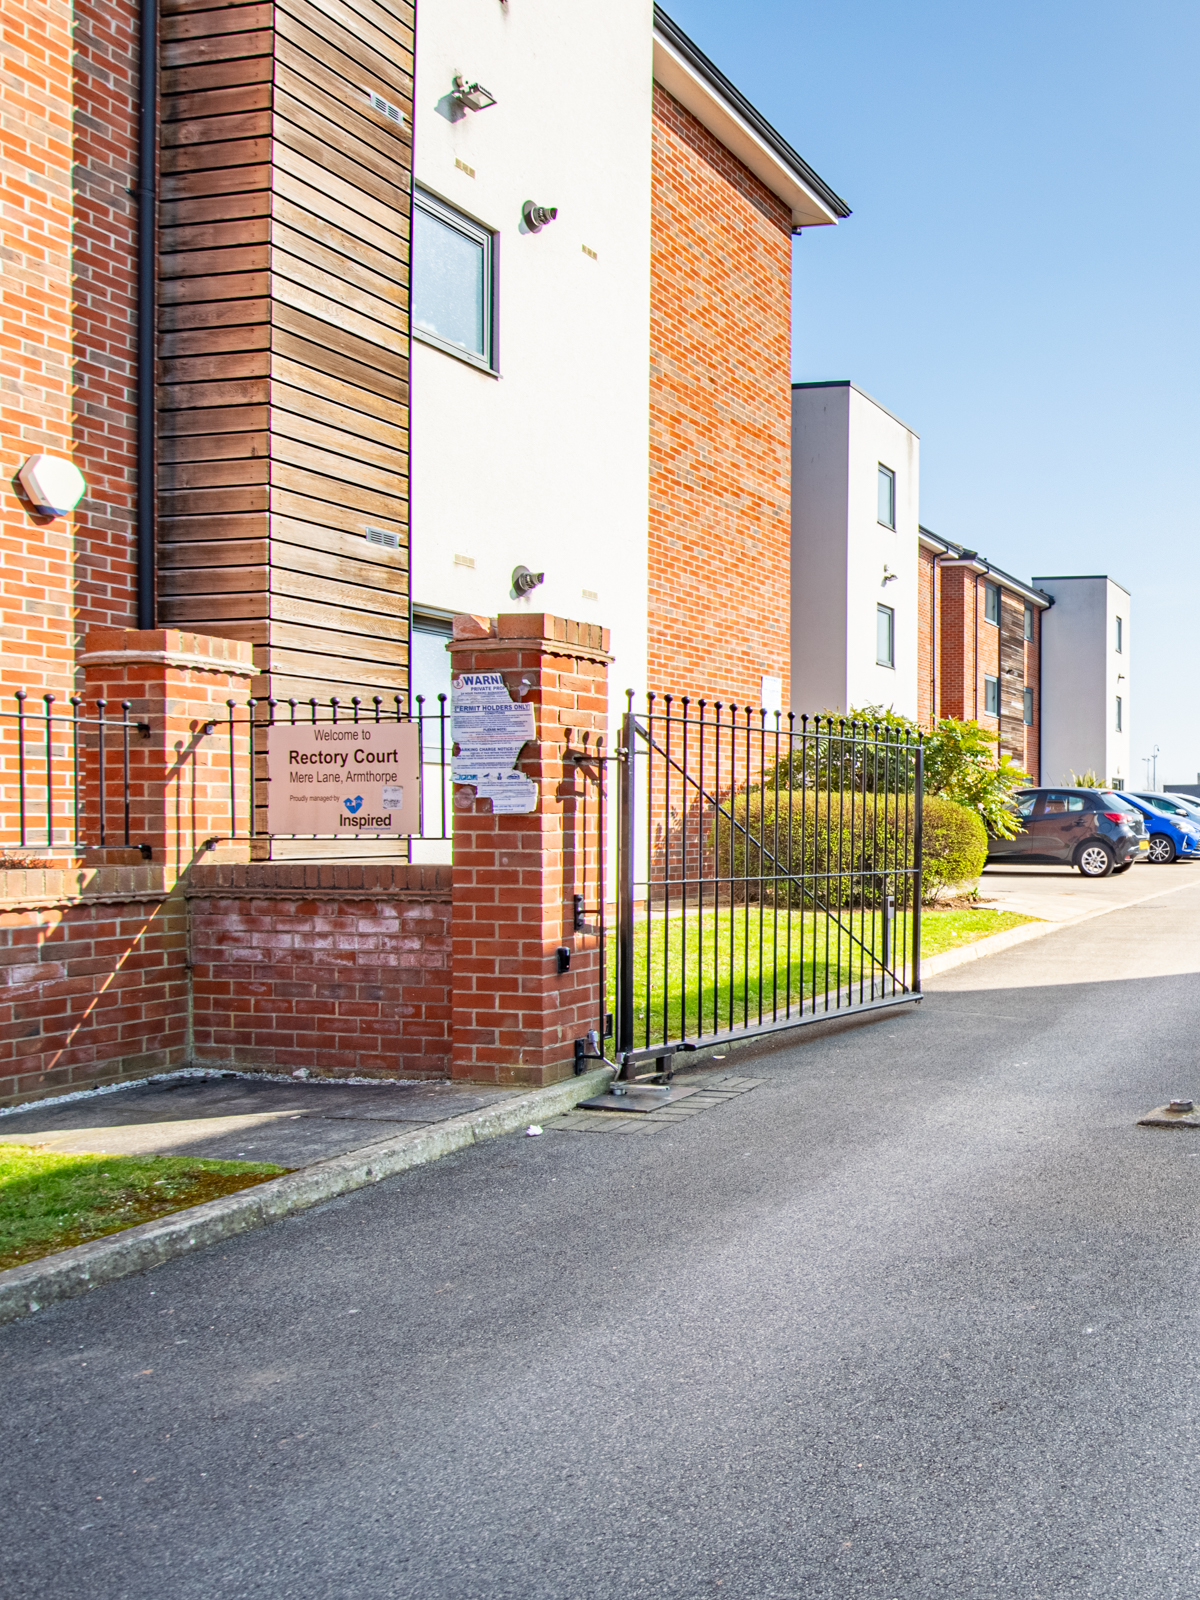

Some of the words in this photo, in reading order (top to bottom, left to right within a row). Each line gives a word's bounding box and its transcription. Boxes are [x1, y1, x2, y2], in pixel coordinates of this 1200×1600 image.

[314, 729, 358, 740] Welcome
[362, 729, 371, 740] to
[289, 749, 349, 768] Rectory
[353, 748, 398, 763] Court
[289, 771, 314, 783] Mere
[316, 771, 343, 784] Lane,
[345, 770, 398, 784] Armthorpe
[339, 813, 392, 830] Inspired
